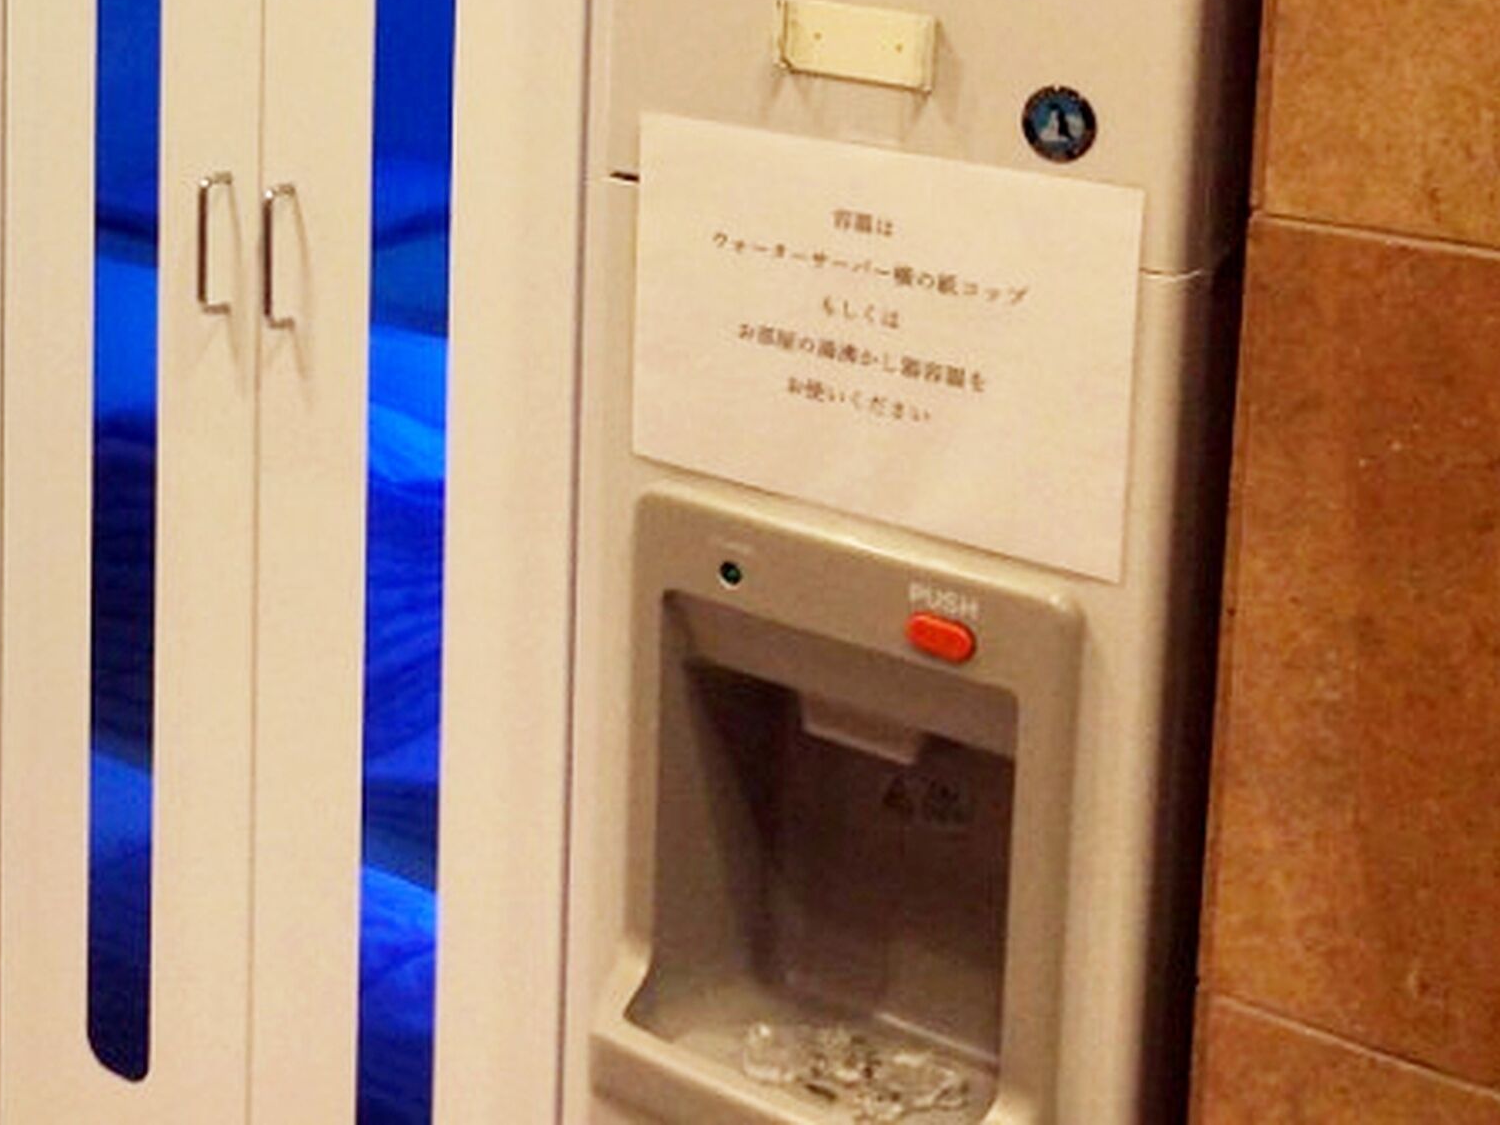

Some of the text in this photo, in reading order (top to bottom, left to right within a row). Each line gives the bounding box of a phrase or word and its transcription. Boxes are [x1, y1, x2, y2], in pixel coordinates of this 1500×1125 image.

[822, 295, 900, 329] もしくは
[787, 376, 931, 422] お使いください
[908, 581, 980, 620] PUSH
